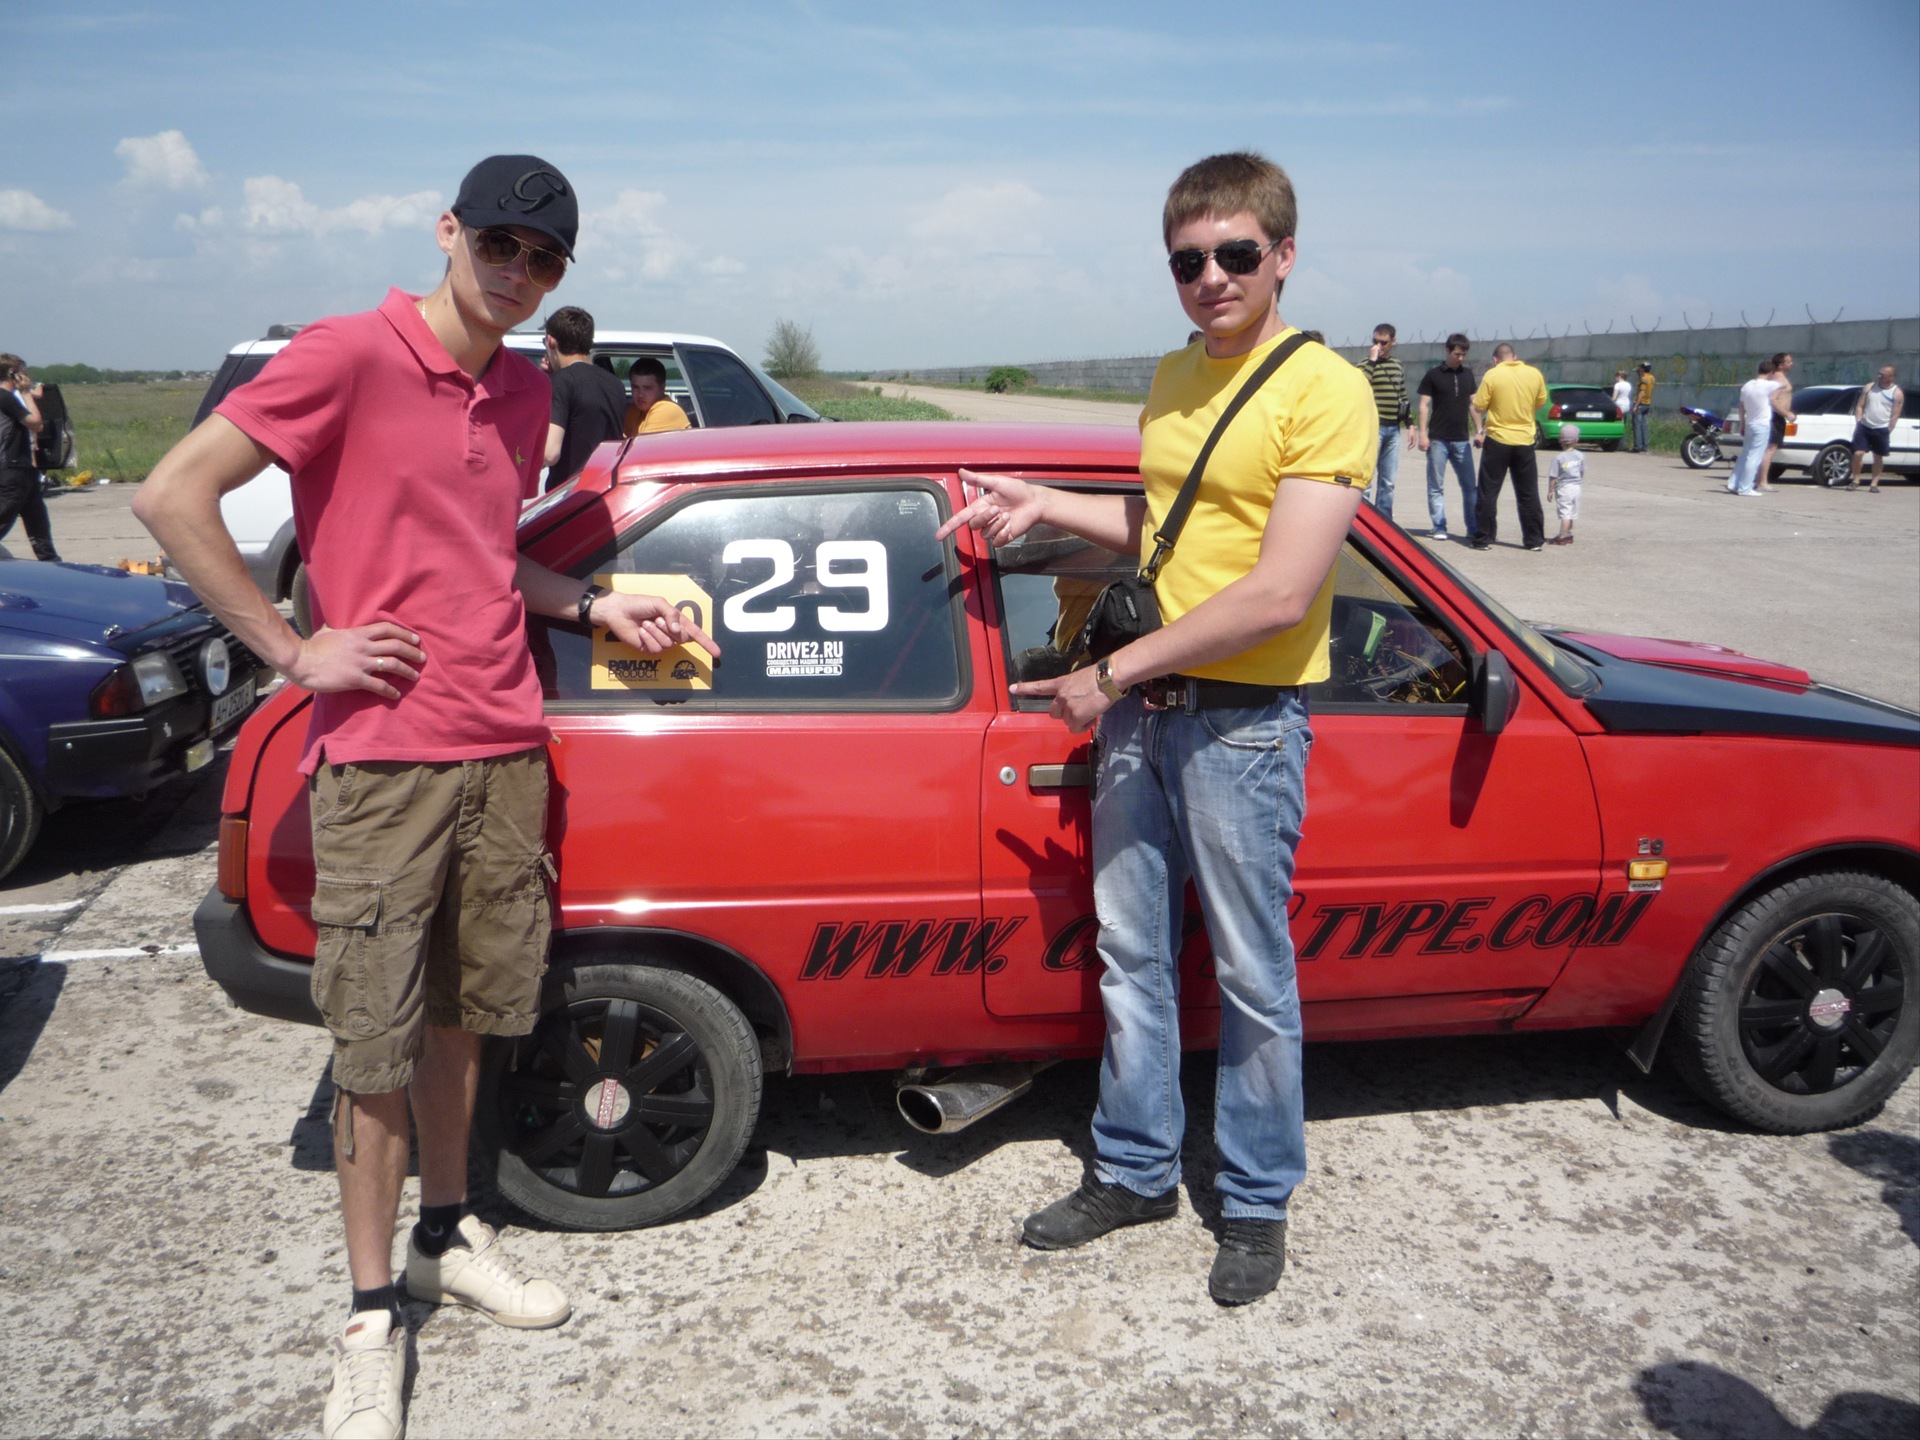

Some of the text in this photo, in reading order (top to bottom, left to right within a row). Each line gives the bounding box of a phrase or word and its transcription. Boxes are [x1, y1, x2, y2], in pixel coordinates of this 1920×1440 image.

[722, 539, 890, 632] 29
[767, 641, 843, 659] DRIVE2.RU
[608, 669, 658, 679] PRODUCT
[769, 666, 840, 675] MARIUPOL
